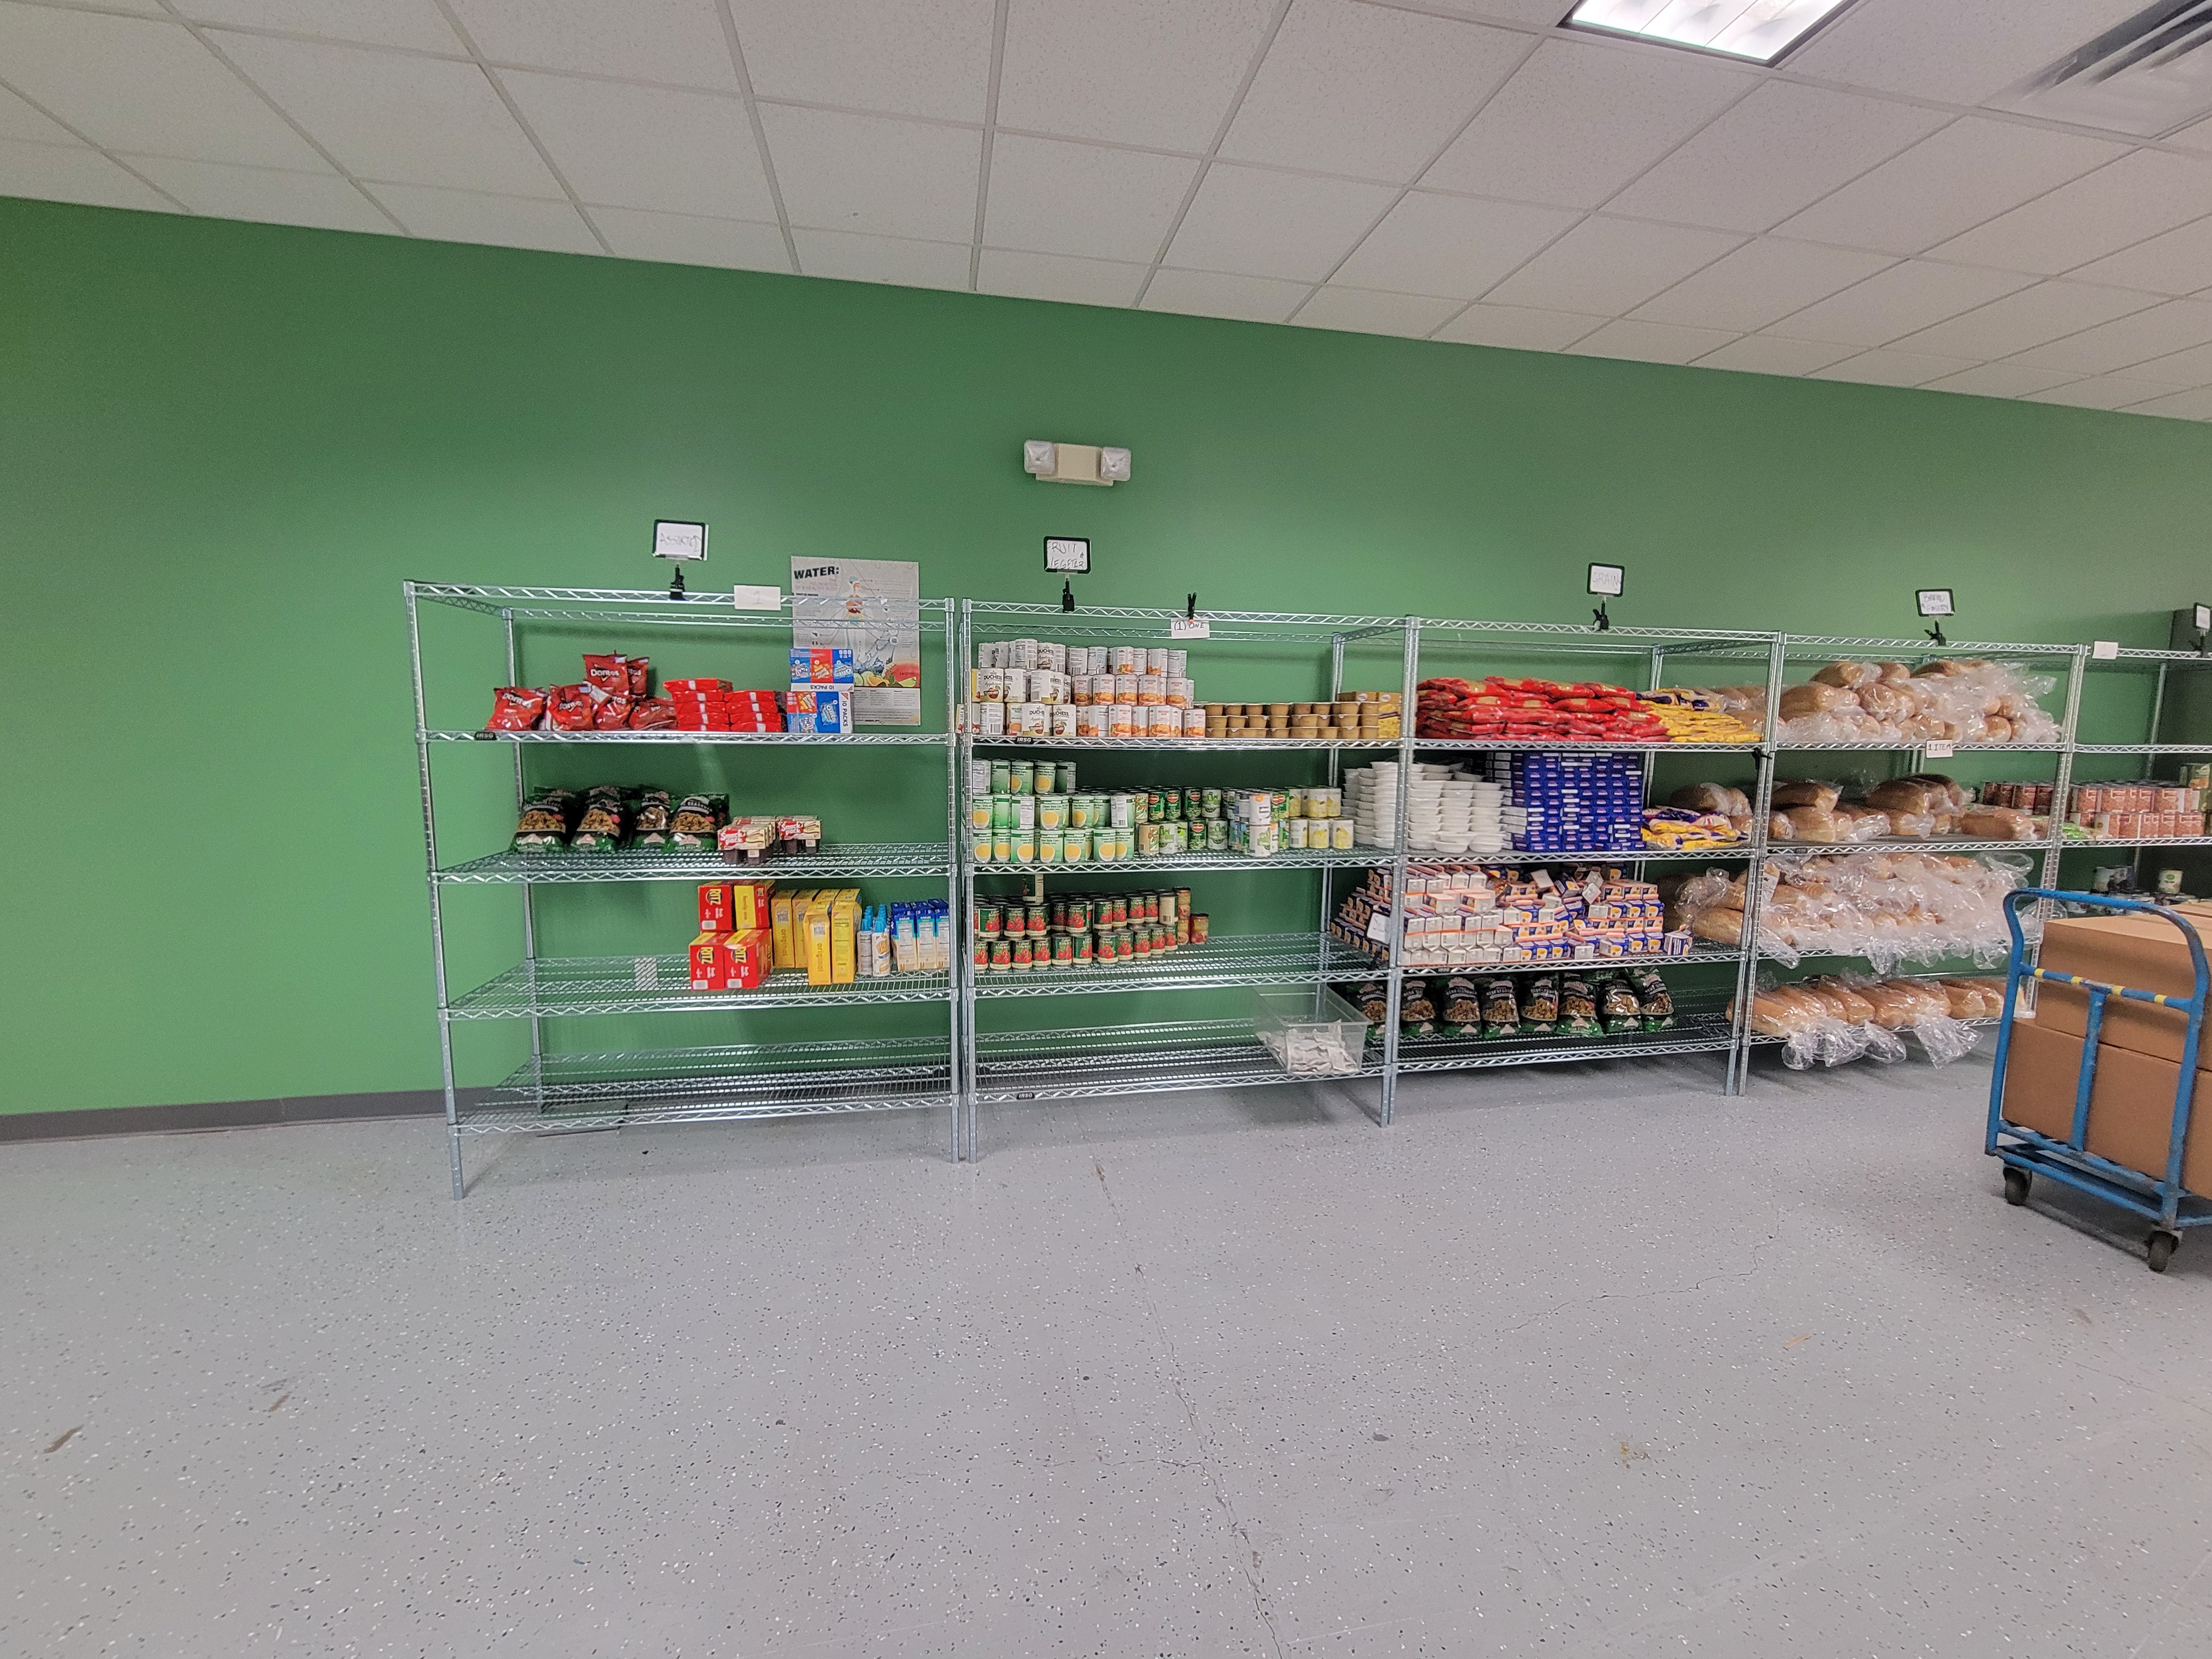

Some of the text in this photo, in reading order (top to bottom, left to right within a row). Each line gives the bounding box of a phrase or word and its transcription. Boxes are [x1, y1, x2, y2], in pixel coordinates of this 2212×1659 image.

[1047, 541, 1077, 554] FRUIT
[793, 566, 839, 580] WATER:
[1174, 620, 1187, 631] (1)
[709, 888, 721, 905] RITZ
[701, 946, 714, 964] RITZ
[735, 946, 747, 963] RITZ
